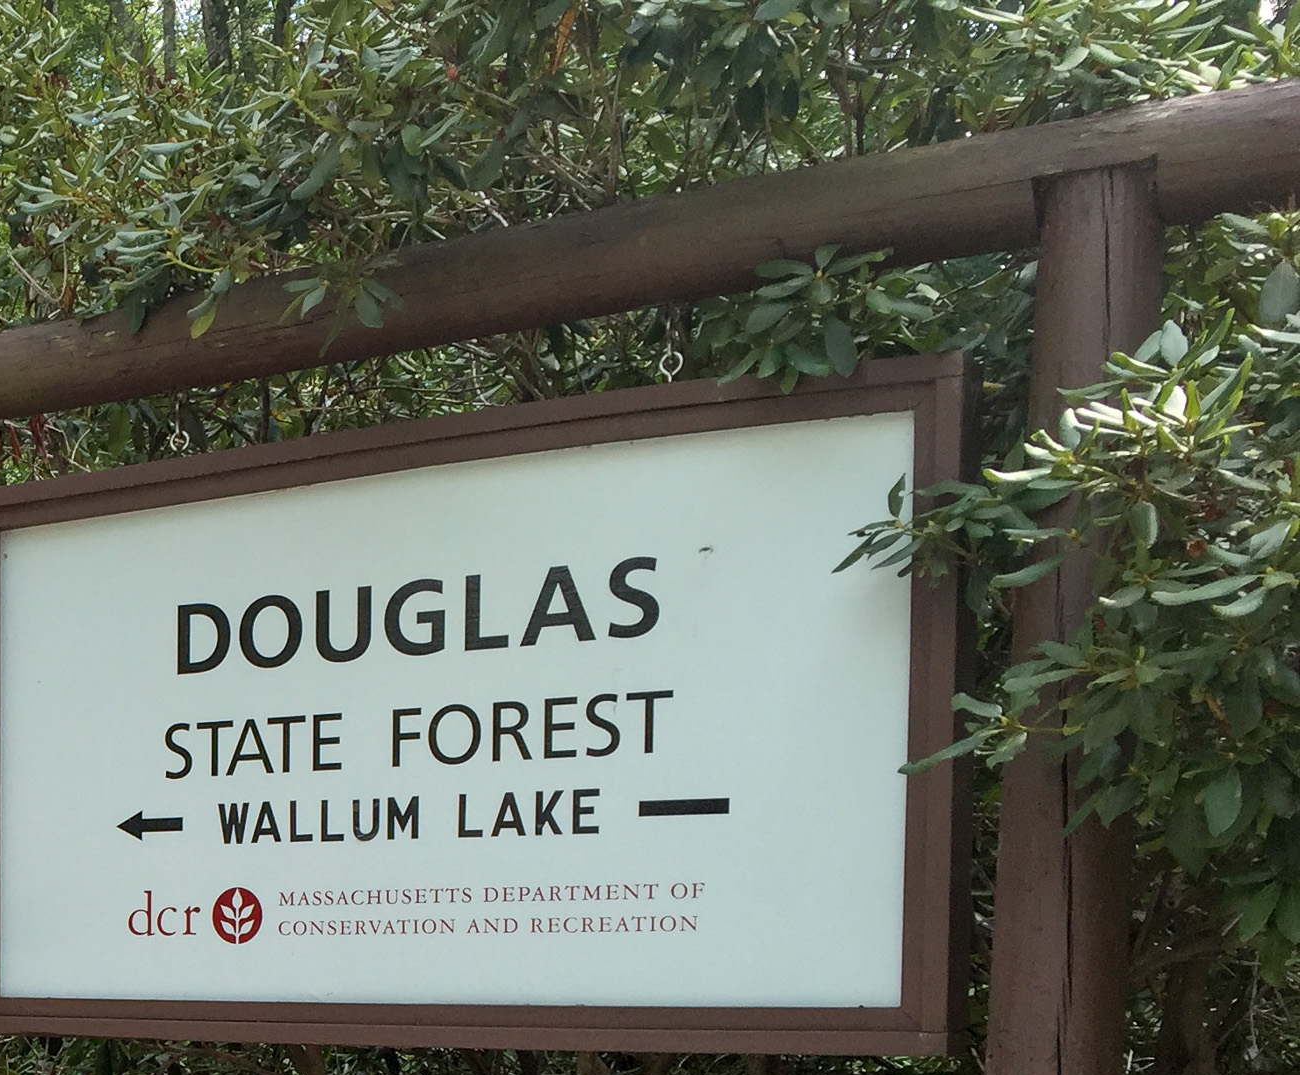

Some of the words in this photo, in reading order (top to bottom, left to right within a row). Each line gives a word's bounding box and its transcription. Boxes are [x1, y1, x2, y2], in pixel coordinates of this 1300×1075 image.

[177, 557, 660, 675] DOUGLAS
[165, 712, 342, 779] STATE
[392, 690, 674, 767] FOREST
[218, 796, 420, 844] WALLUM
[458, 788, 601, 838] LAKE
[127, 890, 201, 937] dcr
[278, 887, 472, 907] MASSACHUSETTS
[483, 883, 658, 903] DEPARTMENT
[670, 882, 705, 900] OF
[278, 918, 455, 936] CONSERVATION
[466, 918, 519, 935] AND
[530, 915, 699, 934] RECREATION
